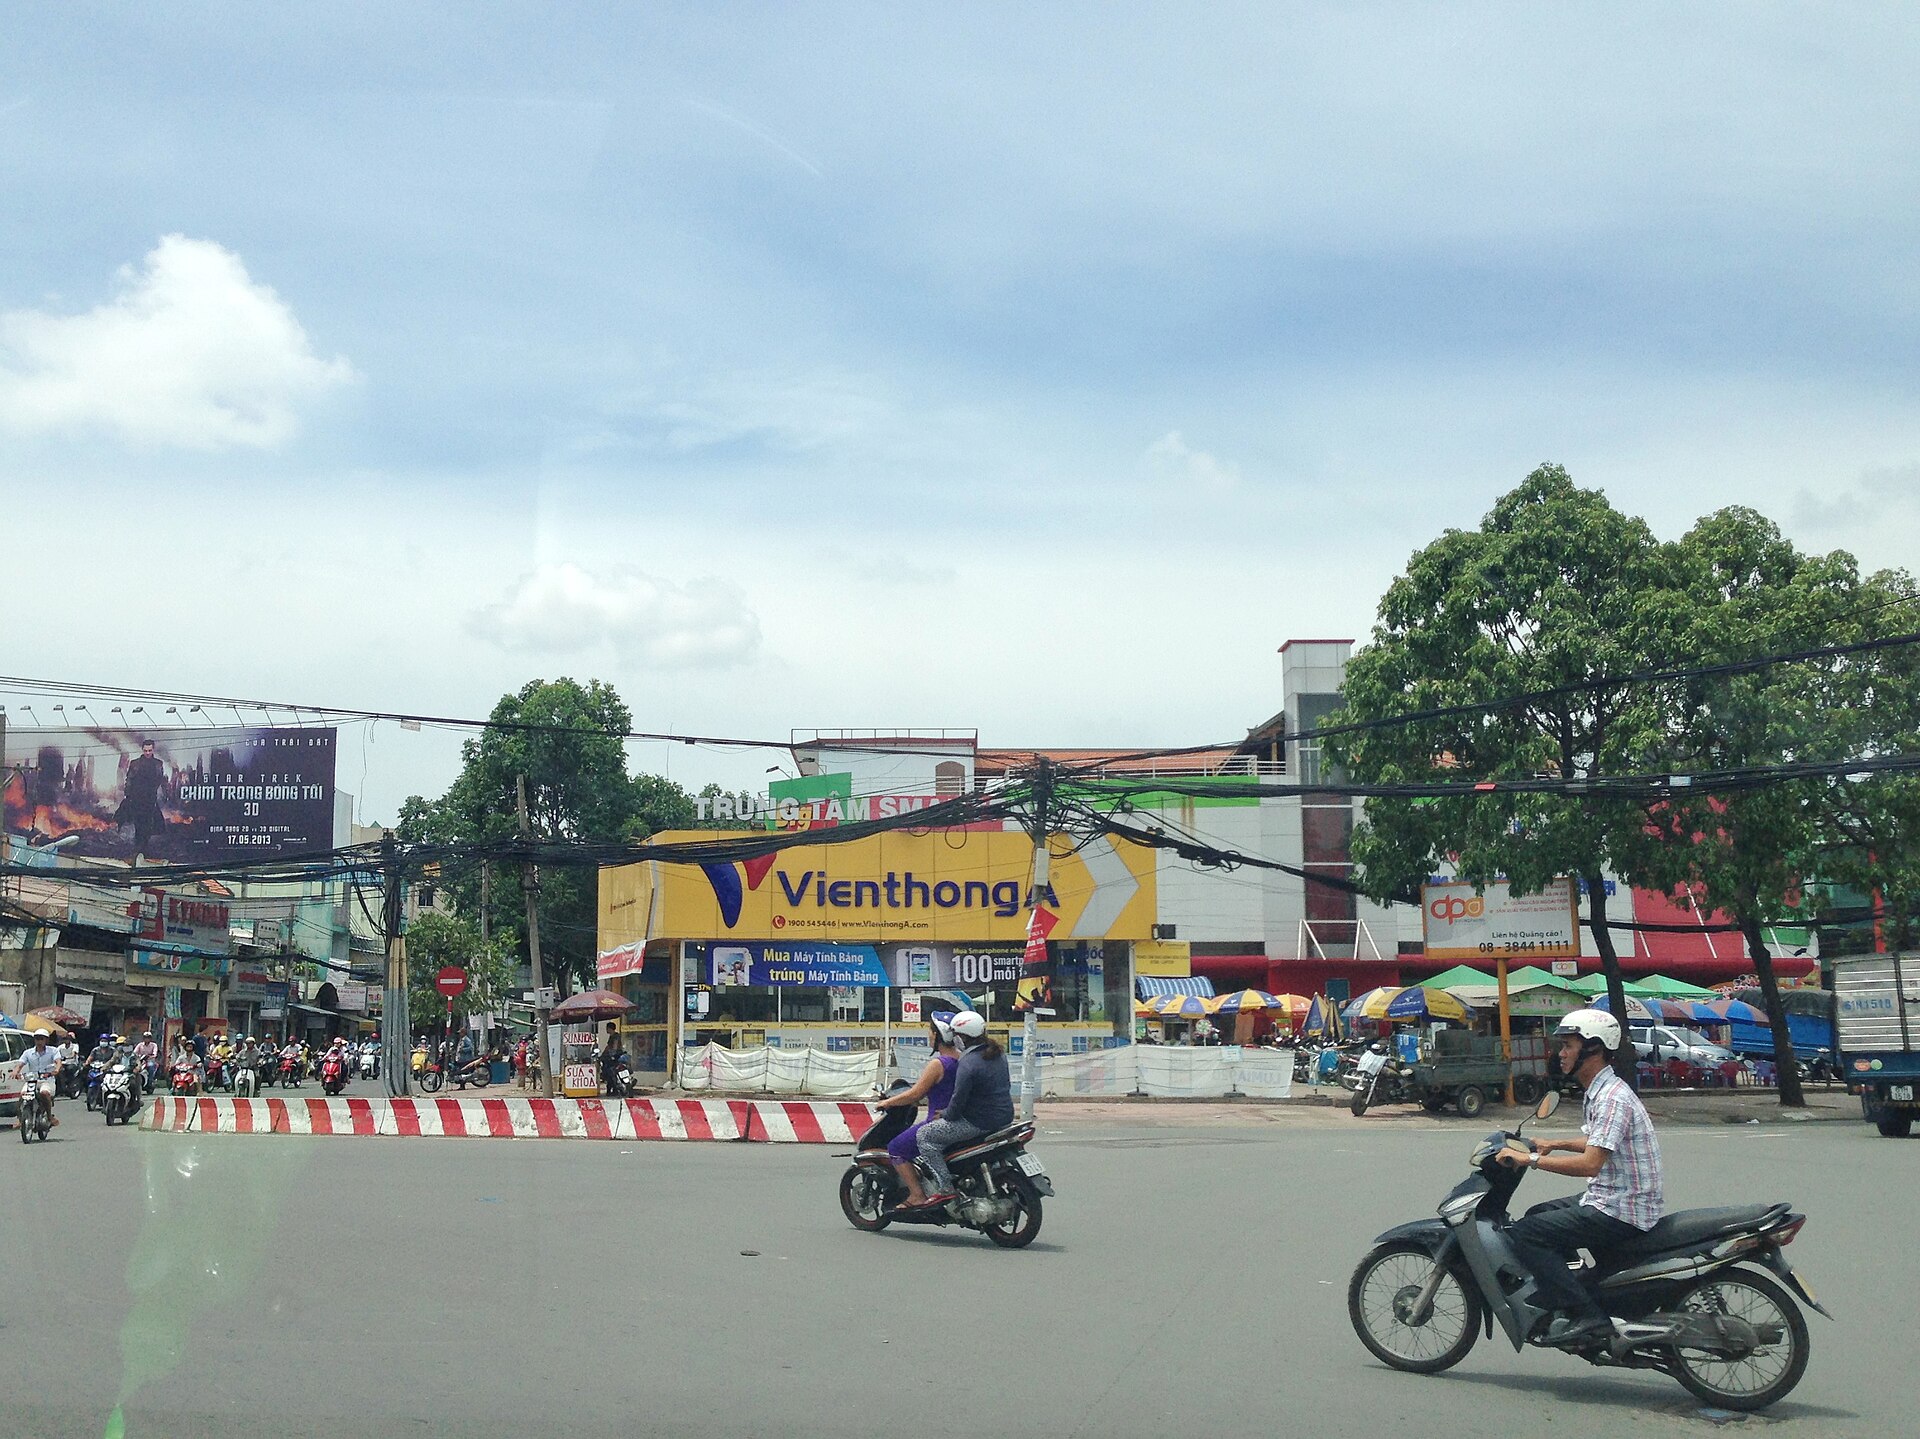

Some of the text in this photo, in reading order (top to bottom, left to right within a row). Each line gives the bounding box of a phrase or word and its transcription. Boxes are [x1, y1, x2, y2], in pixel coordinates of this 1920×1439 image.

[203, 773, 302, 783] STAR TREK
[220, 785, 263, 800] TRONG
[243, 802, 259, 816] 3D
[693, 797, 800, 821] TRUNG
[813, 790, 870, 821] TÂM
[227, 835, 271, 845] 17.05.2013
[788, 919, 805, 927] 1900
[968, 947, 1009, 955] Smartphone
[1479, 942, 1494, 953] 08
[1504, 940, 1535, 952] 3844
[1538, 939, 1569, 951] 1111
[763, 948, 791, 962] Mua
[793, 951, 814, 965] Máy
[815, 951, 837, 963] Tính
[993, 955, 1025, 970] smartp
[769, 967, 879, 984] trúng Máy Tính Bảng
[951, 954, 993, 983] 100
[903, 1001, 919, 1013] 0%
